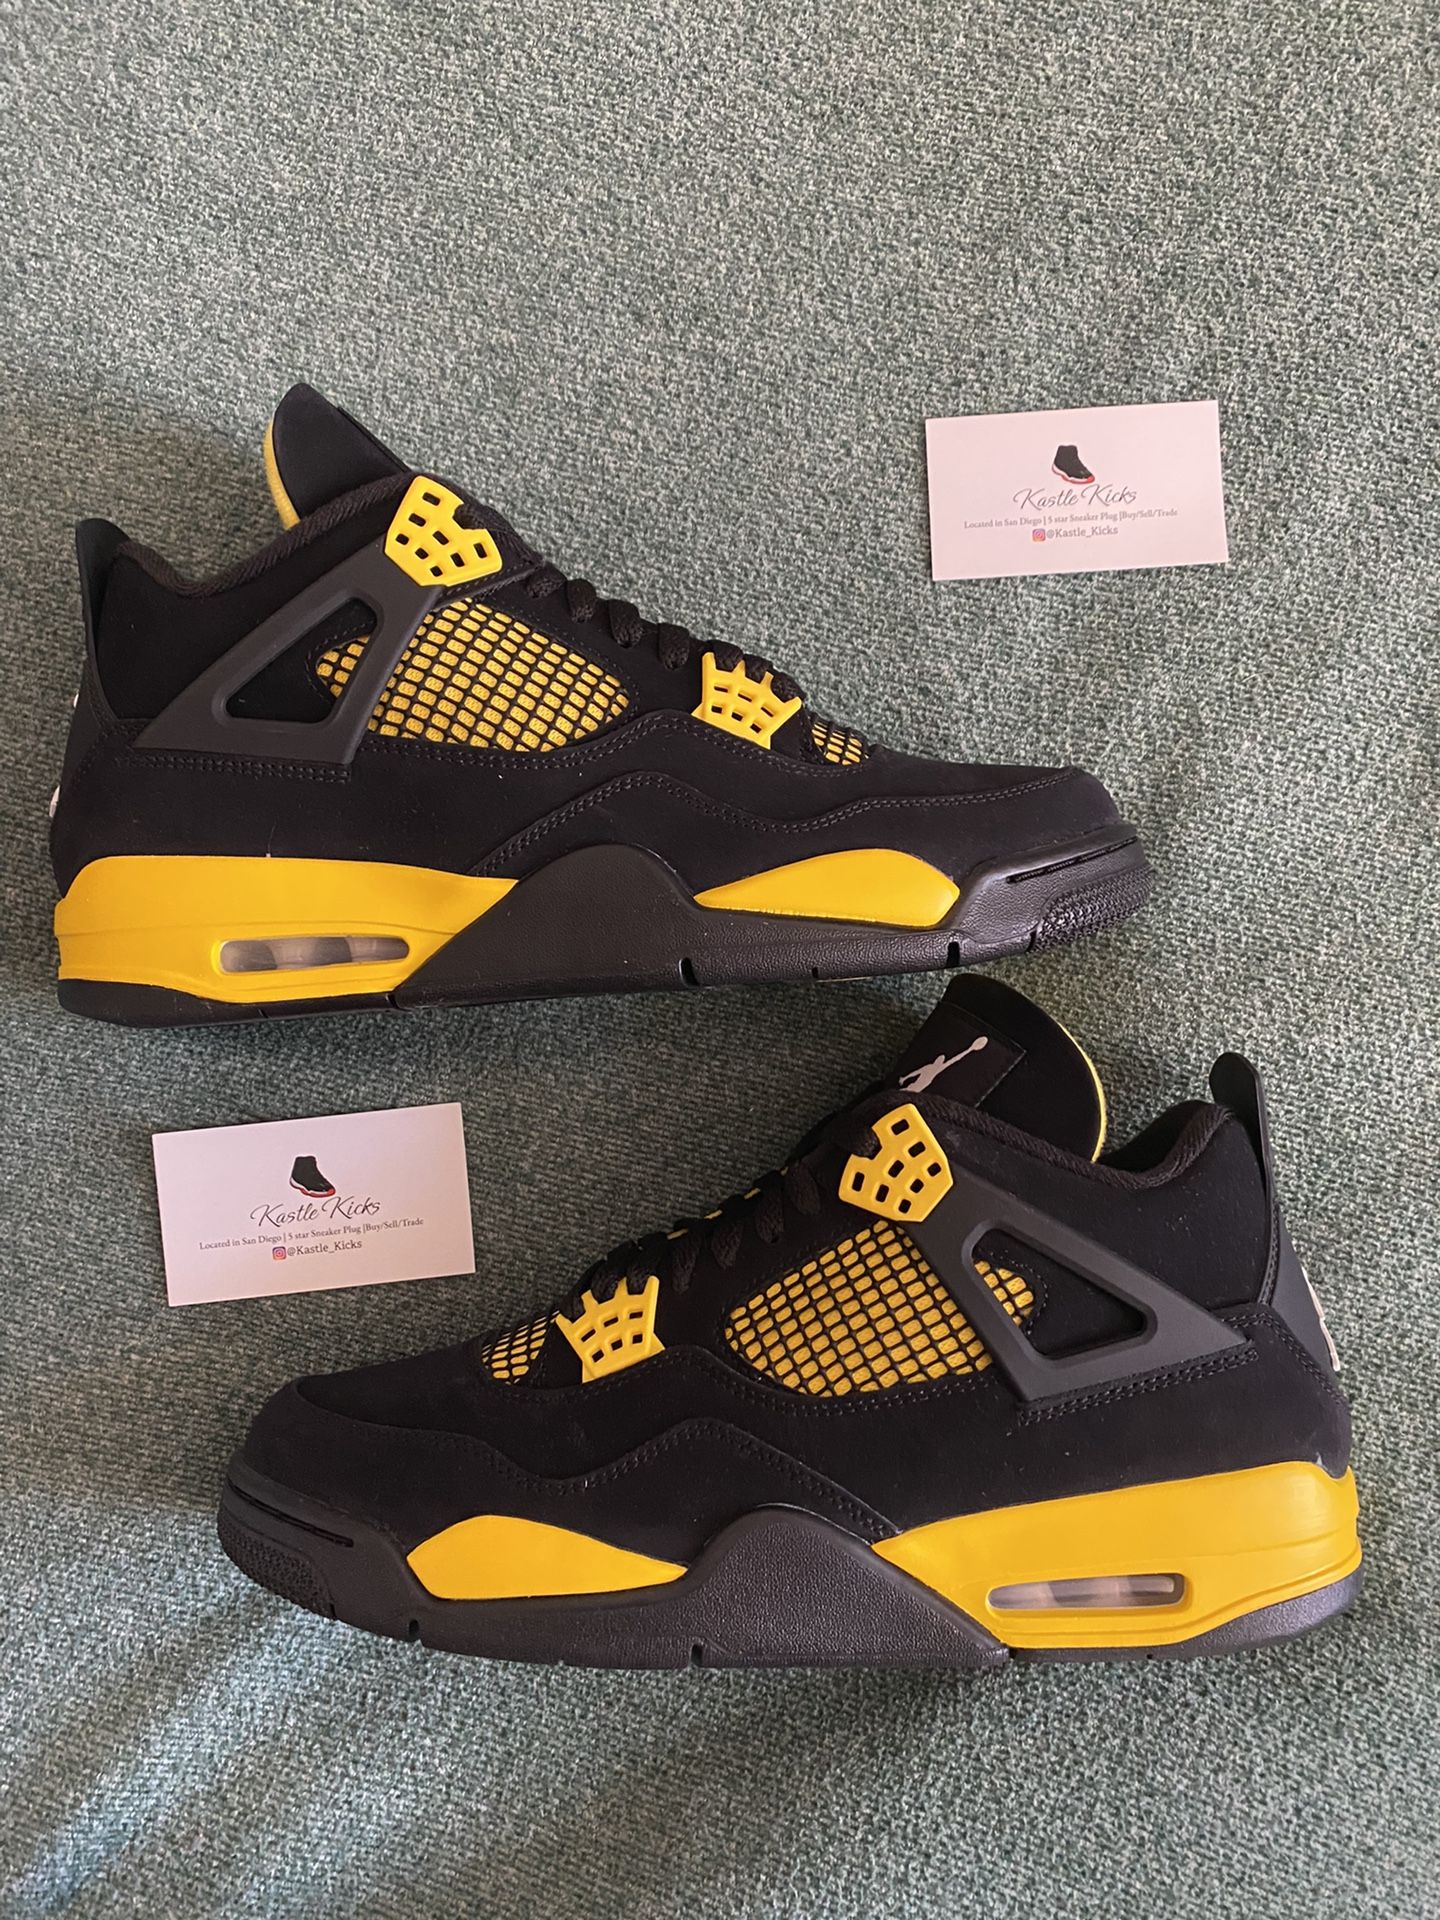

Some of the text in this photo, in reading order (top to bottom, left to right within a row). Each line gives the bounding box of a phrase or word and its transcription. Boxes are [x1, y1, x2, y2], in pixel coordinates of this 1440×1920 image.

[1012, 483, 1138, 511] Kastle Kicks
[964, 518, 993, 529] Located
[994, 518, 1003, 528] in
[1004, 517, 1018, 526] San
[1019, 516, 1042, 527] Diego
[1048, 515, 1053, 524] 5
[1054, 515, 1069, 524] star
[1070, 513, 1099, 523] Sneaker
[1100, 511, 1118, 523] Plug
[1046, 525, 1118, 539] @Kastle_Kicks
[249, 1195, 381, 1228] Kastle Kicks
[199, 1238, 231, 1250] Located
[232, 1238, 241, 1247] in
[242, 1236, 257, 1245] San
[258, 1233, 282, 1245] Diego
[288, 1232, 293, 1241] 5
[294, 1230, 309, 1240] star
[311, 1227, 342, 1238] Sneaker
[343, 1225, 362, 1237] Plug
[287, 1239, 362, 1257] @Kastle_Kicks
